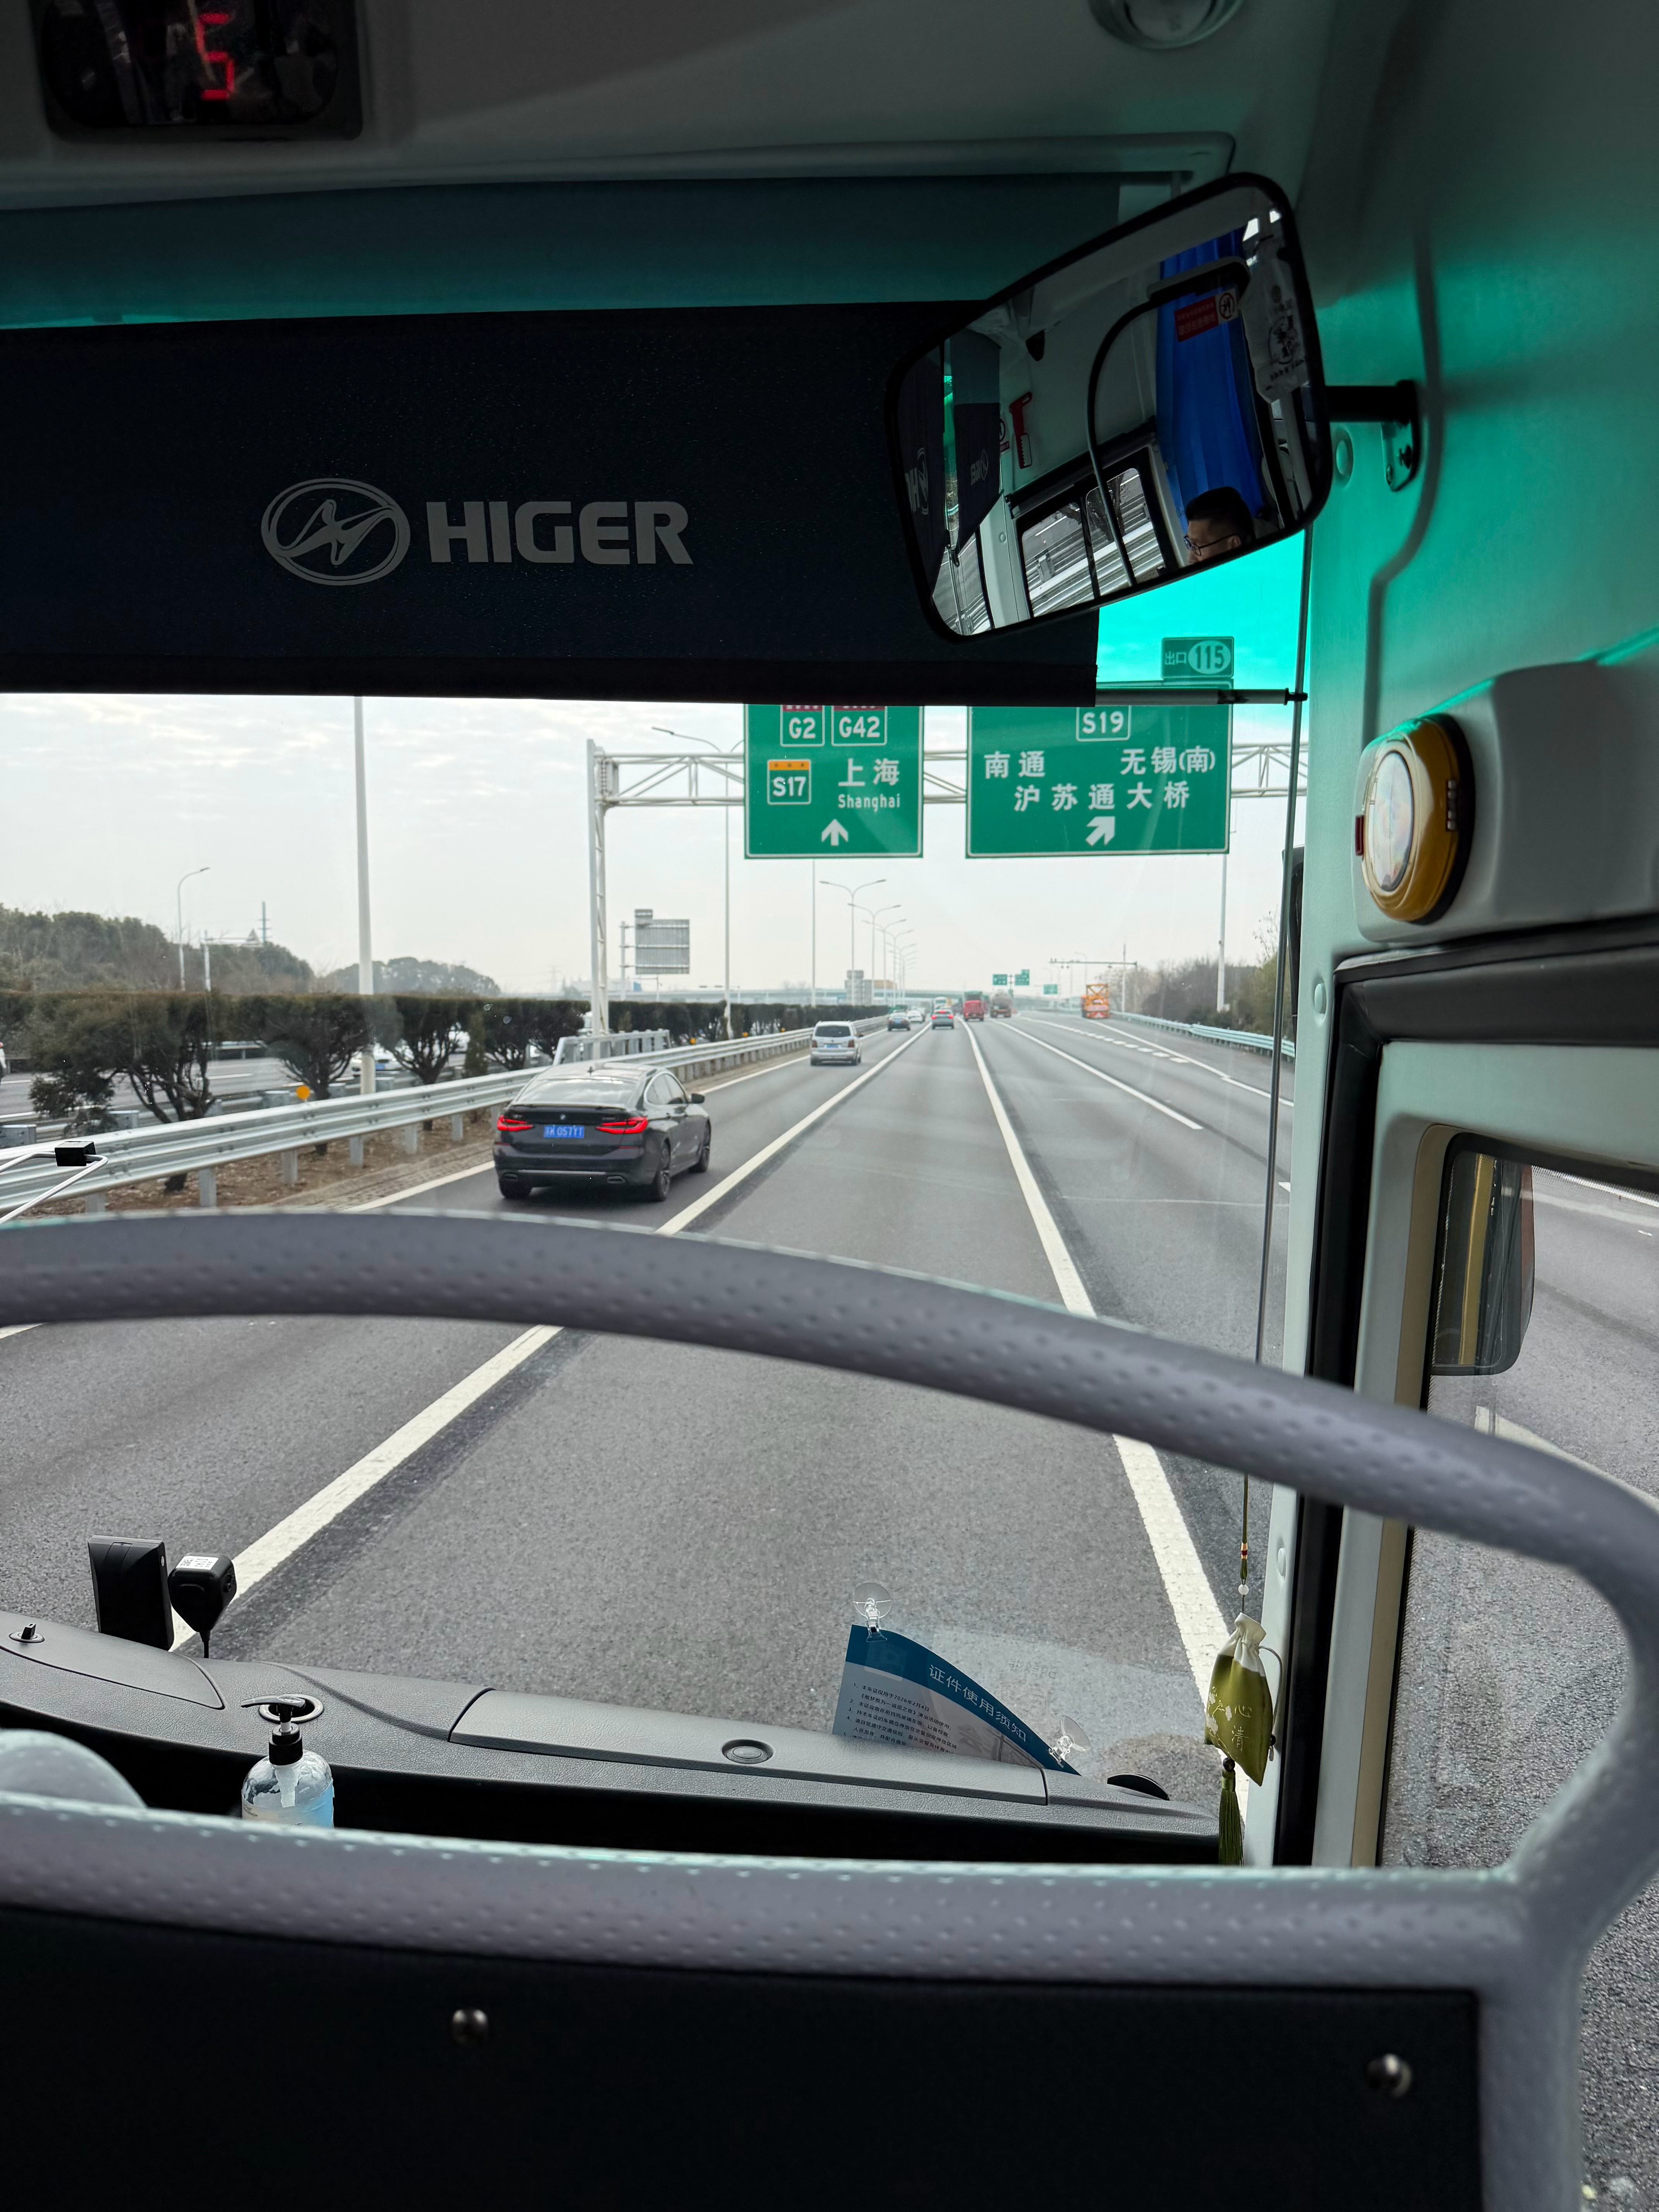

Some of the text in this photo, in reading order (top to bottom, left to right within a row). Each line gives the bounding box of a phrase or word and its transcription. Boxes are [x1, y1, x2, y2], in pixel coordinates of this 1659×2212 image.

[426, 501, 694, 565] HIGER
[1164, 645, 1223, 670] 出口 115
[788, 717, 816, 739] G2
[838, 716, 881, 738] G42
[1082, 711, 1124, 734] S19
[838, 758, 900, 787] 上海
[984, 750, 1046, 779] 南通
[772, 776, 806, 797] S17
[1013, 781, 1190, 812] 沪苏通大桥
[838, 793, 900, 812] Shanghai
[929, 1664, 1026, 1742] 证件使用须知
